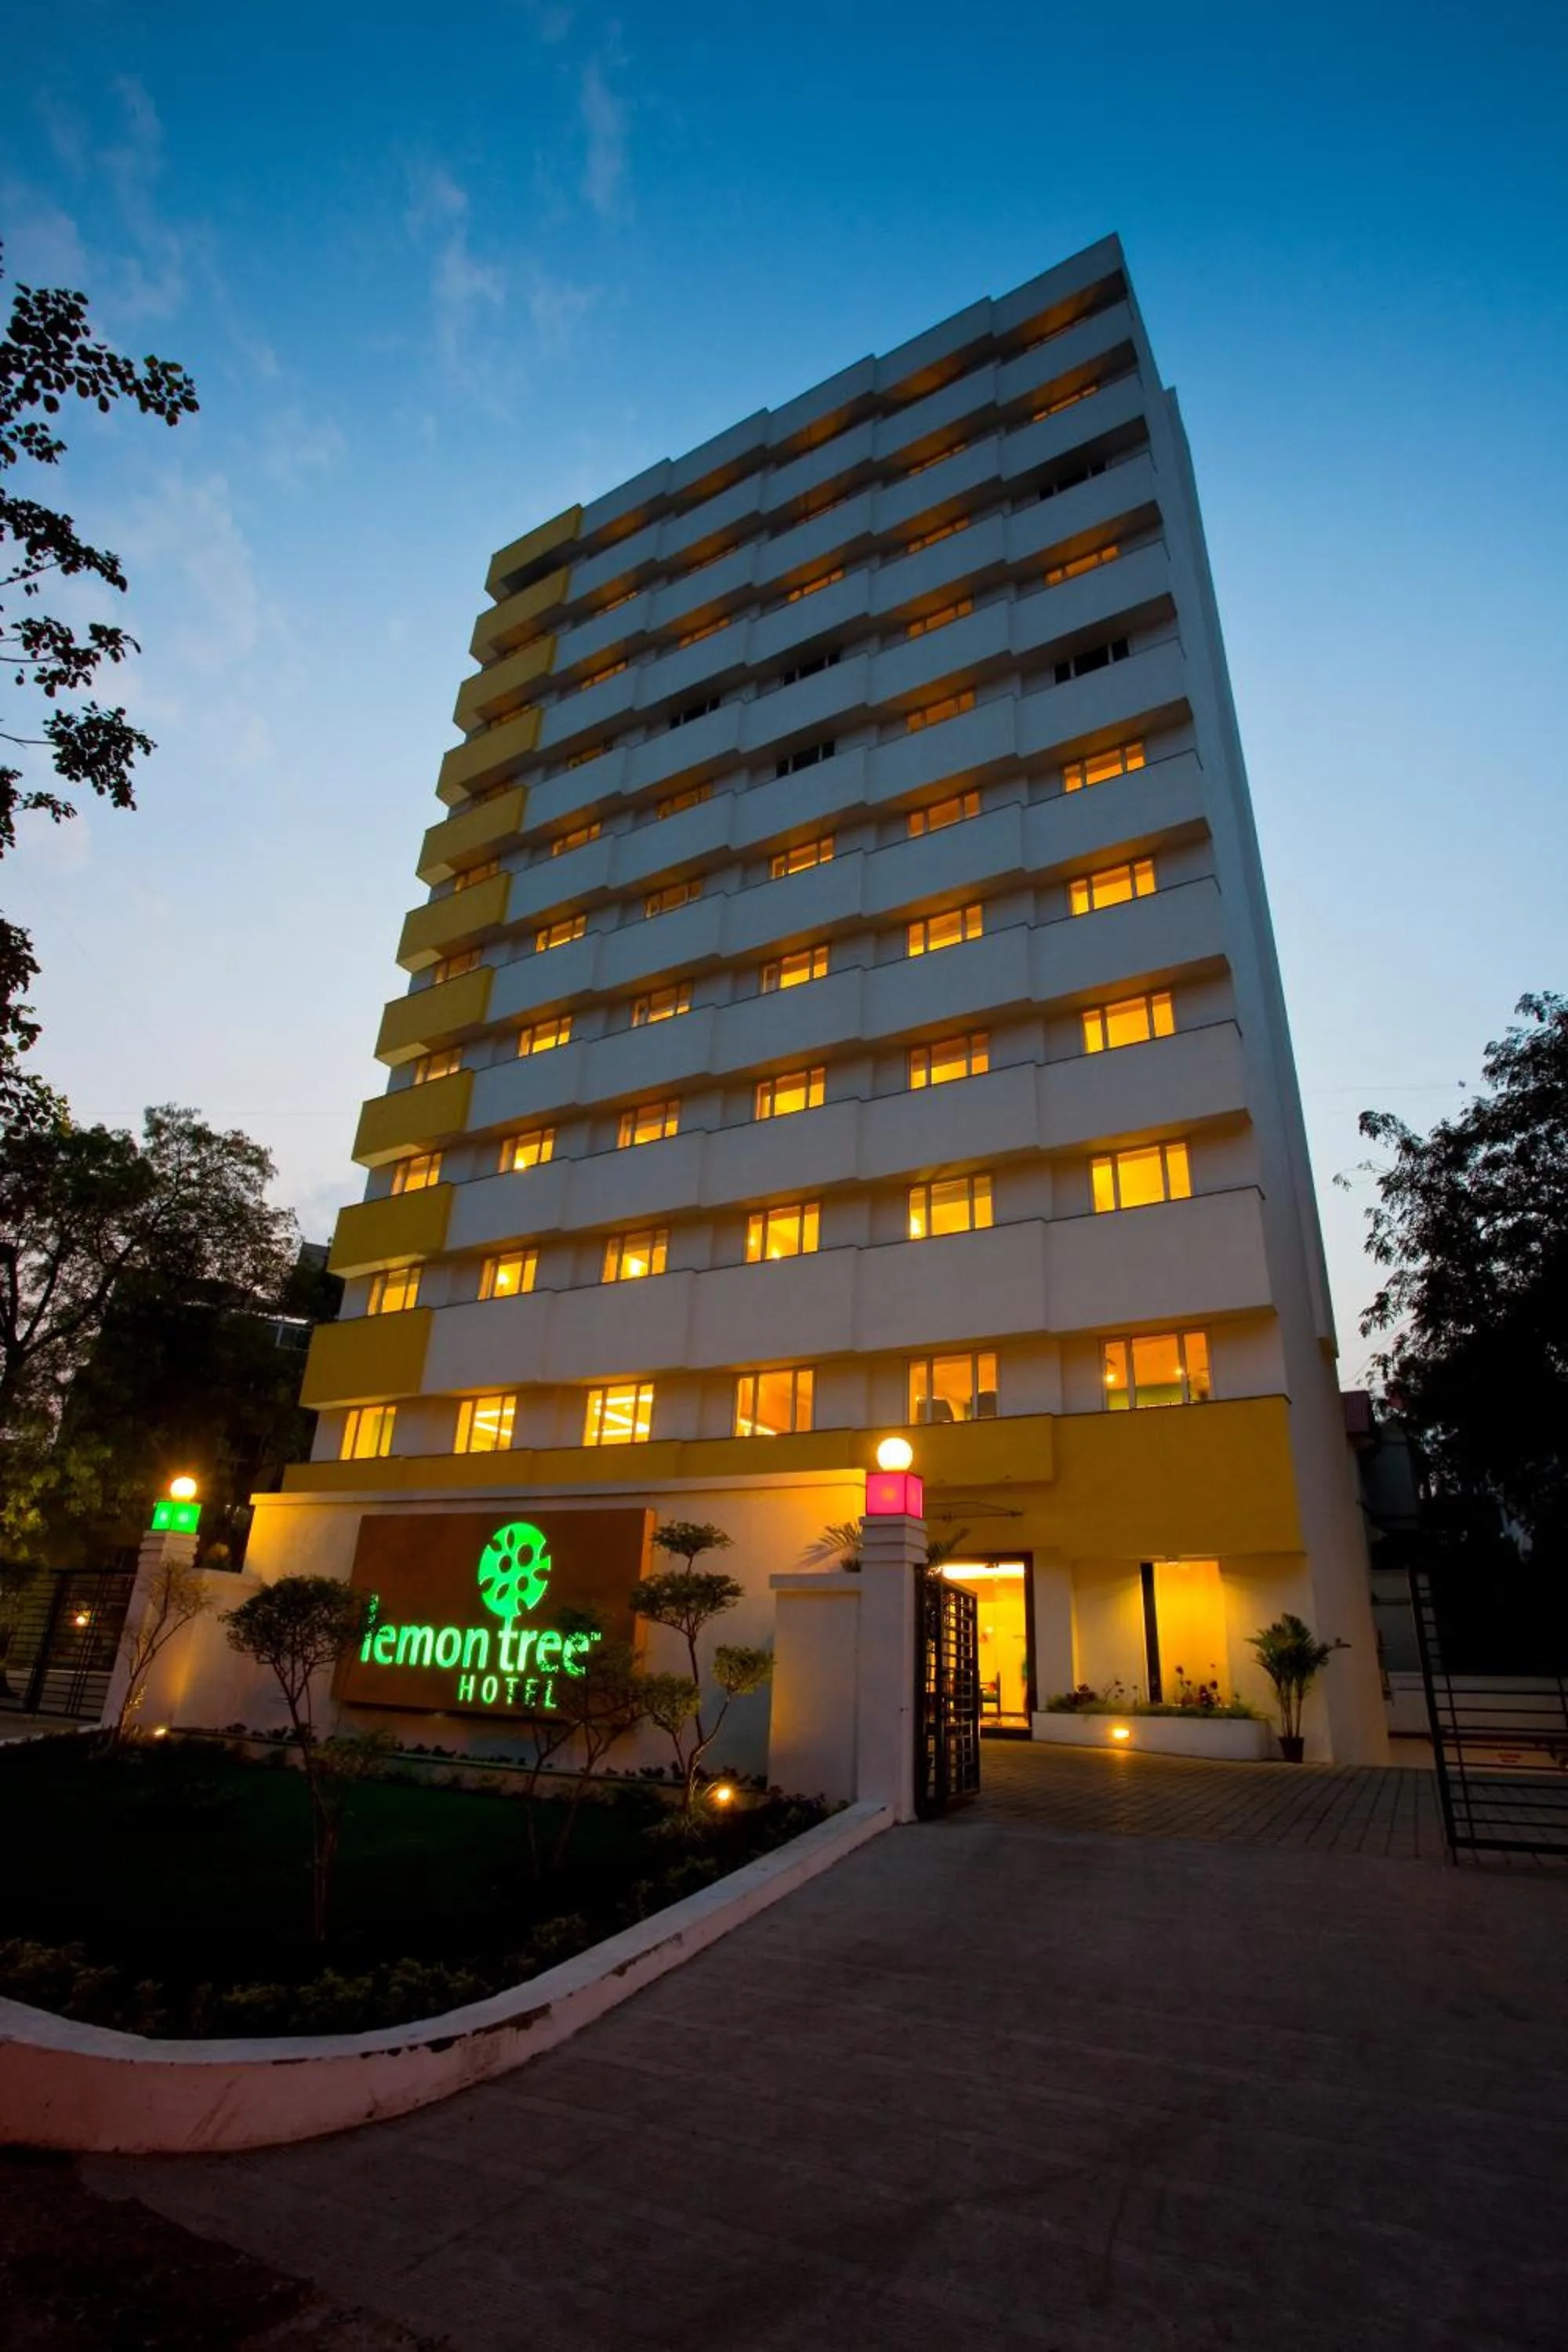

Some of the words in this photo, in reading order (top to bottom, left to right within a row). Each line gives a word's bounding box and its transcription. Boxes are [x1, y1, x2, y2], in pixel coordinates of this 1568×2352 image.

[361, 1594, 489, 1669] lemon
[499, 1617, 590, 1675] tree
[458, 1675, 557, 1708] HOTEL
